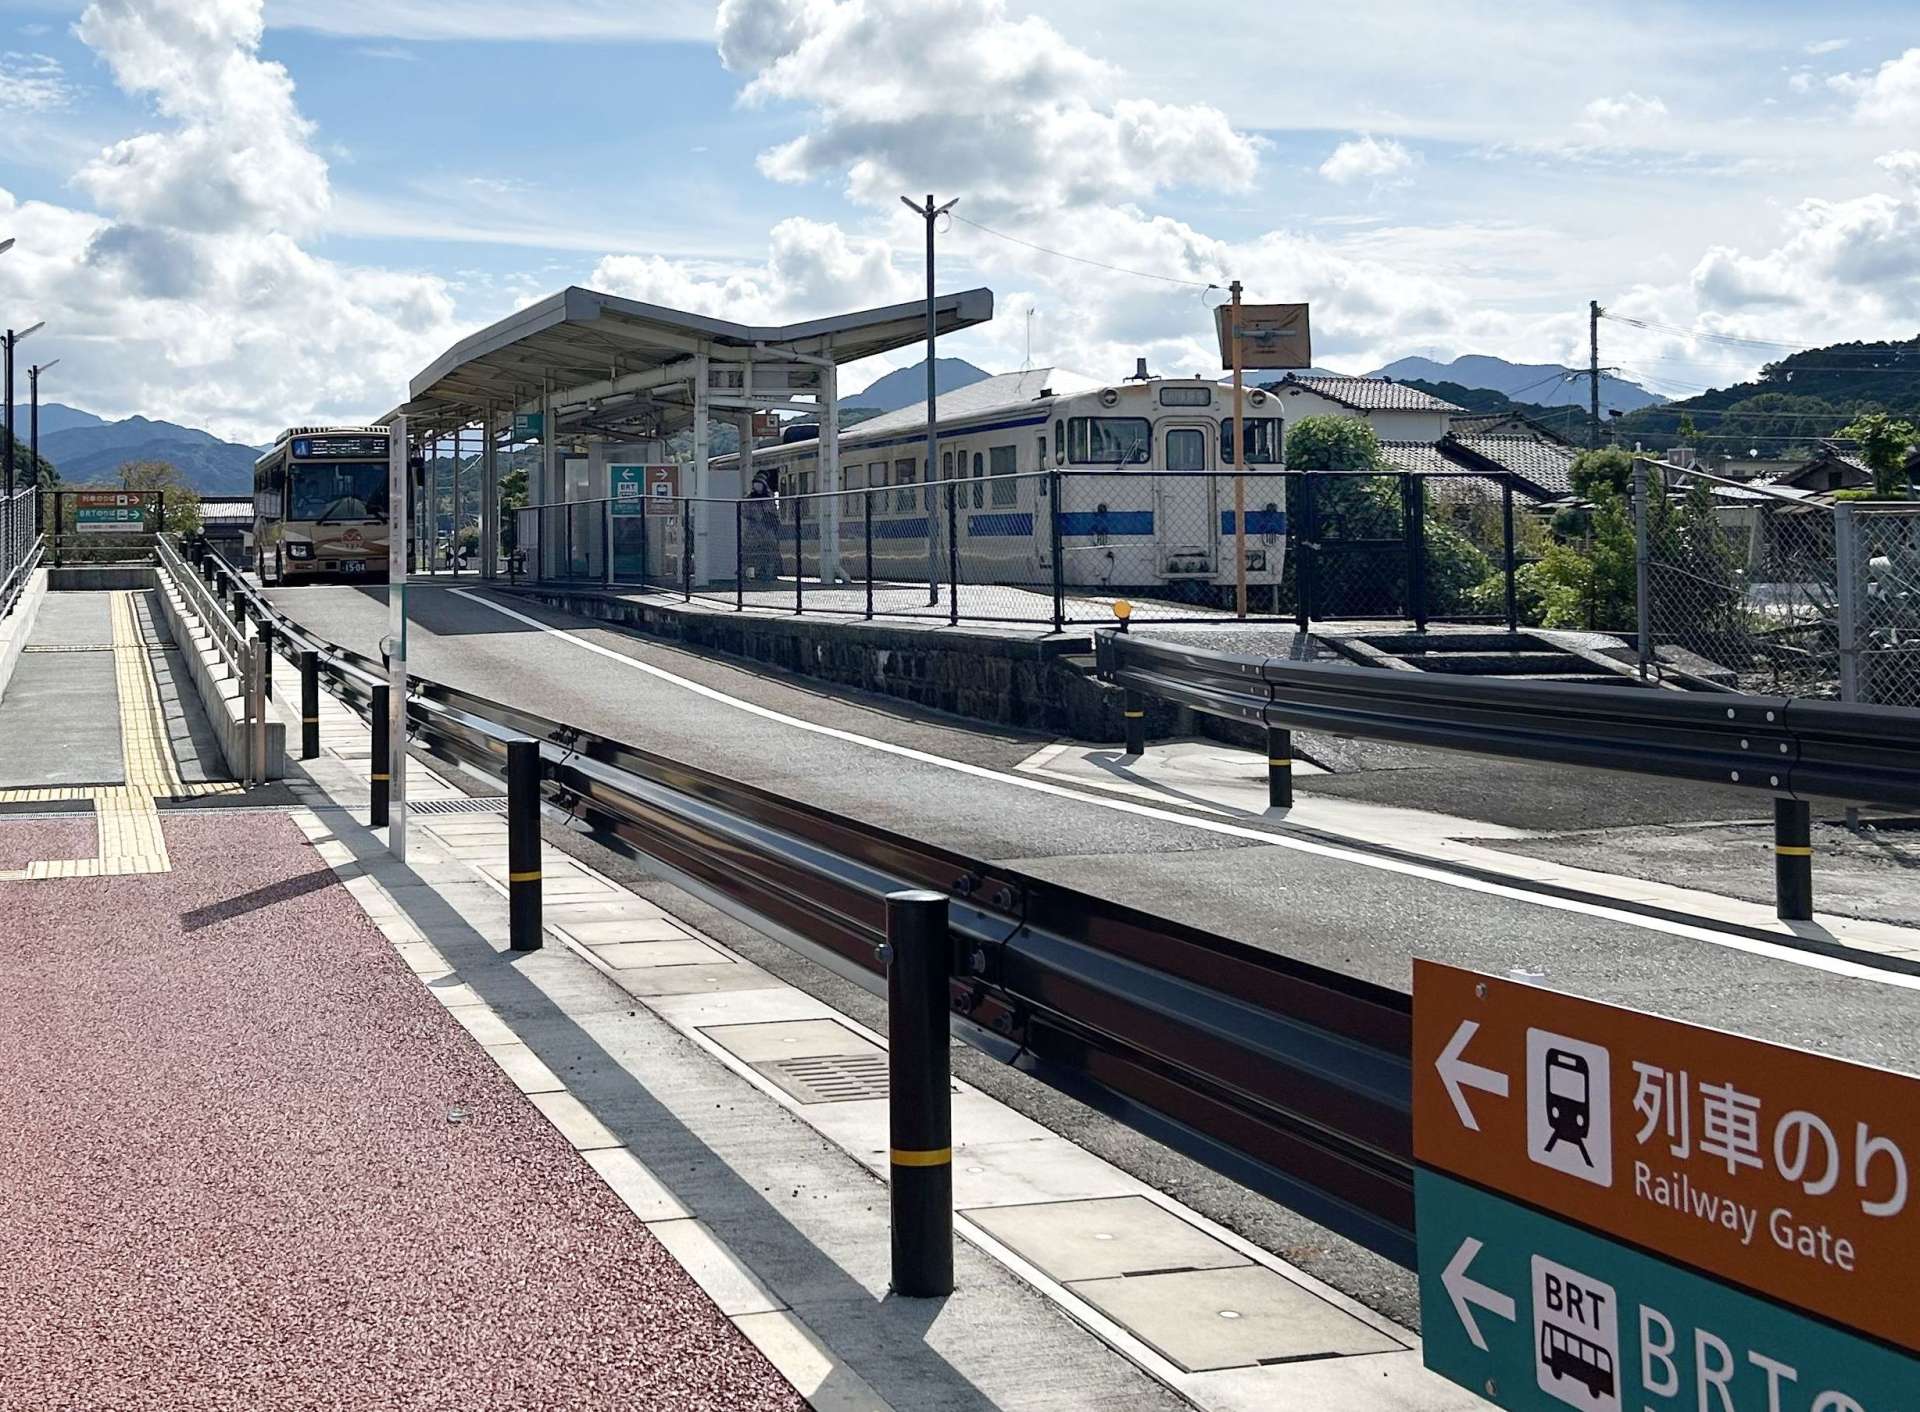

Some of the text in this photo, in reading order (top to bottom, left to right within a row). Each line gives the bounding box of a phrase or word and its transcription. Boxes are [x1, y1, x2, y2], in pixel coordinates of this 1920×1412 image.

[1635, 1161, 1855, 1272] Railway Gate
[1544, 1273, 1605, 1331] BRT
